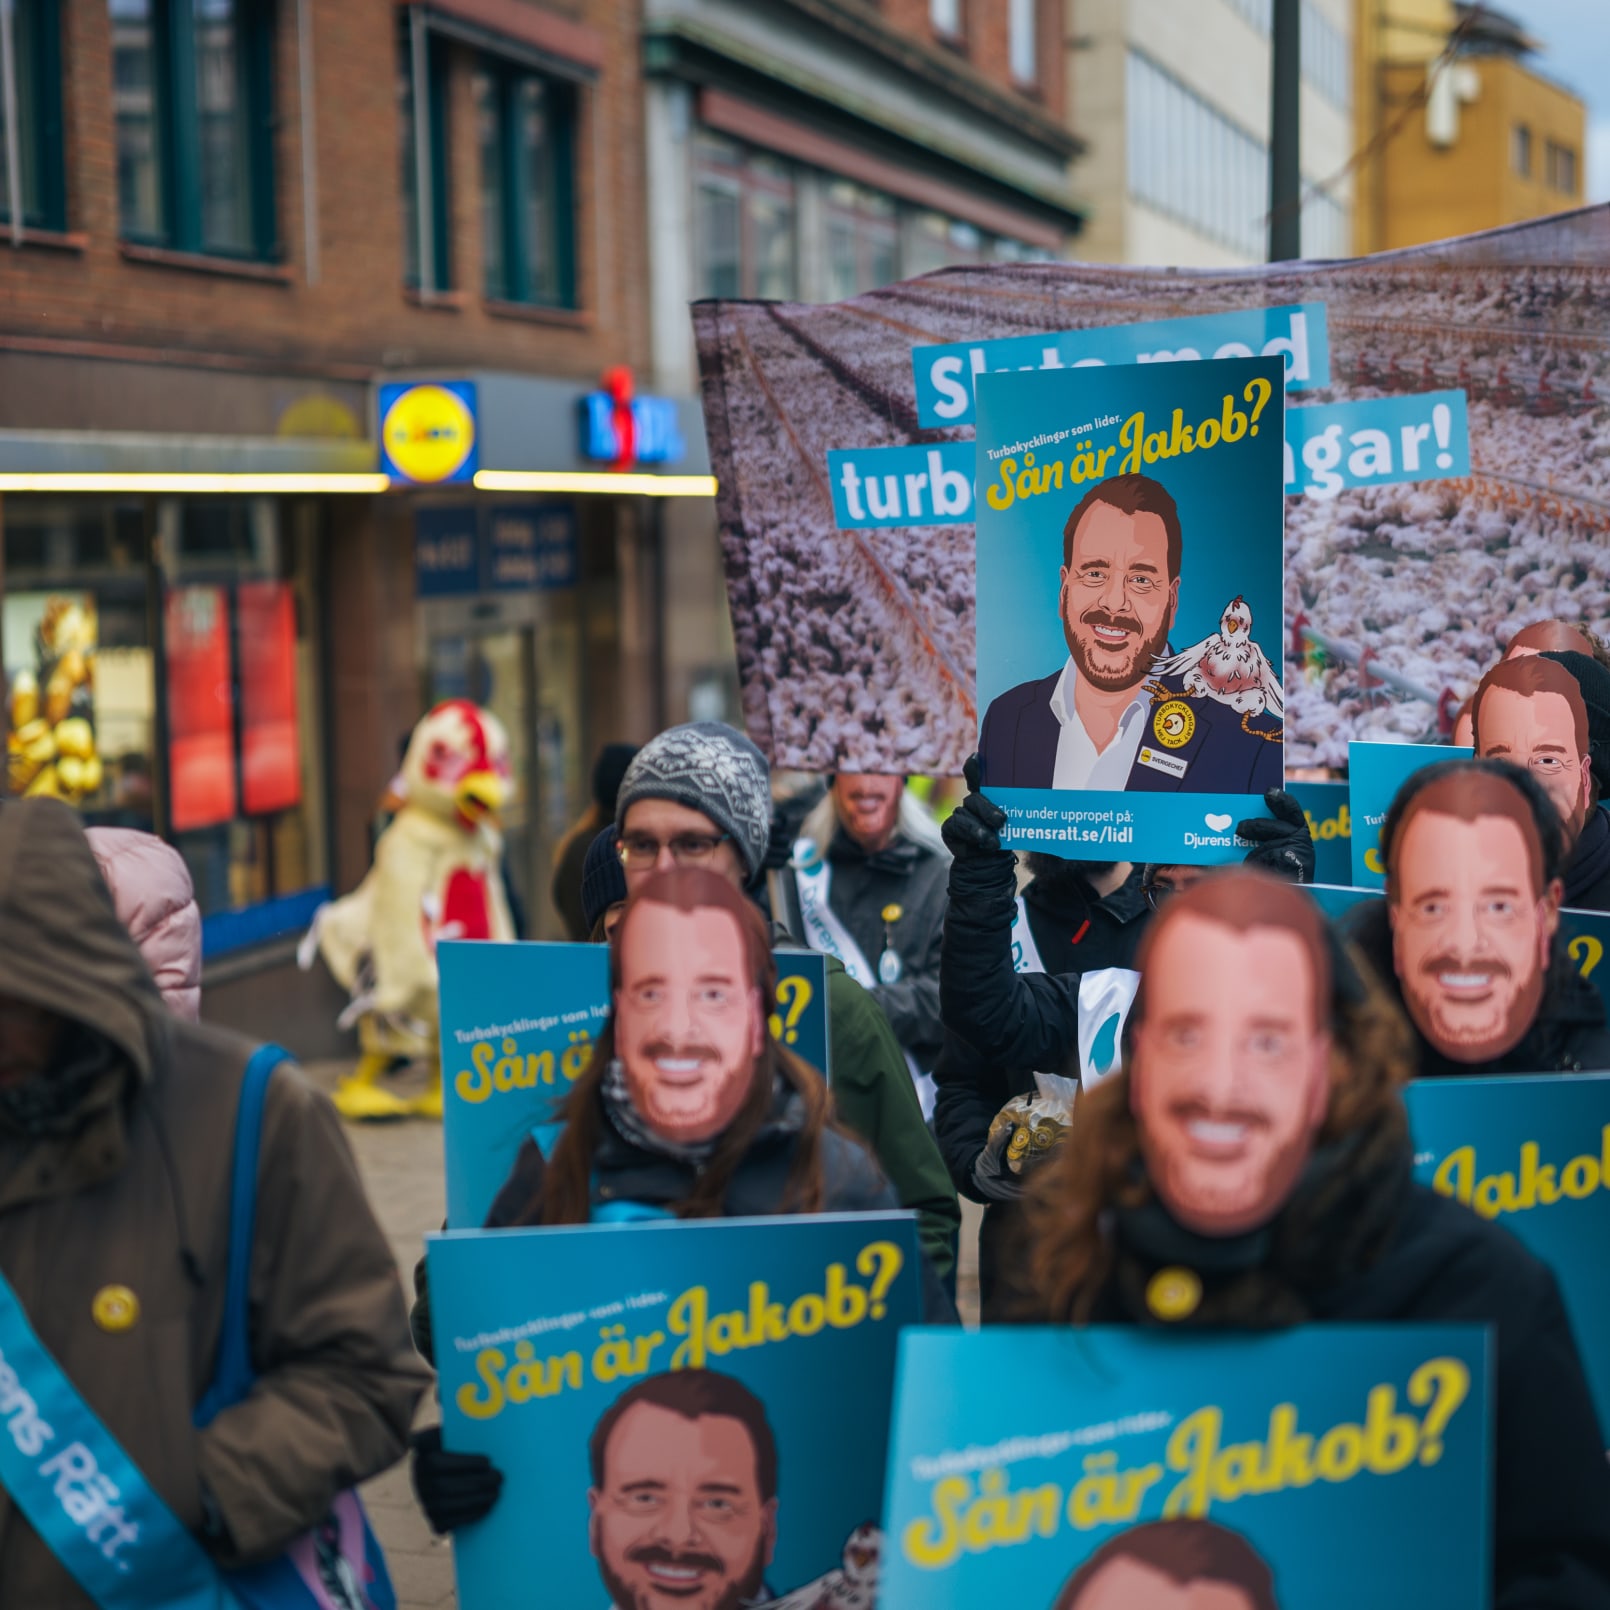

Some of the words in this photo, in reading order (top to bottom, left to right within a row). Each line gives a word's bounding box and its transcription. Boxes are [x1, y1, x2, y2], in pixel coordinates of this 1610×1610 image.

[986, 452, 1063, 511] Sån
[1070, 439, 1116, 484] är
[1119, 377, 1272, 475] Jakob?
[987, 428, 1070, 461] Turbokycklingar
[1072, 422, 1093, 436] som
[1095, 414, 1123, 429] lider.
[840, 450, 976, 520] turb
[1167, 737, 1183, 745] TACK
[999, 824, 1133, 844] djurensratt.se/lidl
[1026, 806, 1058, 820] under
[1061, 810, 1114, 824] uppropet
[1116, 810, 1134, 824] på:
[1184, 832, 1231, 849] Djurens
[454, 1015, 559, 1044] Turbokycklingar
[561, 1008, 588, 1024] som
[455, 1037, 555, 1104] Sån
[561, 1029, 594, 1081] ä
[1432, 1123, 1610, 1221] Jako
[456, 1339, 583, 1420] Sån
[592, 1323, 665, 1383] är
[667, 1240, 903, 1370] Jakob?
[0, 1346, 55, 1457] ens
[903, 1468, 1062, 1569] Sån
[1068, 1450, 1164, 1531] är
[1162, 1356, 1471, 1520] Jakob?
